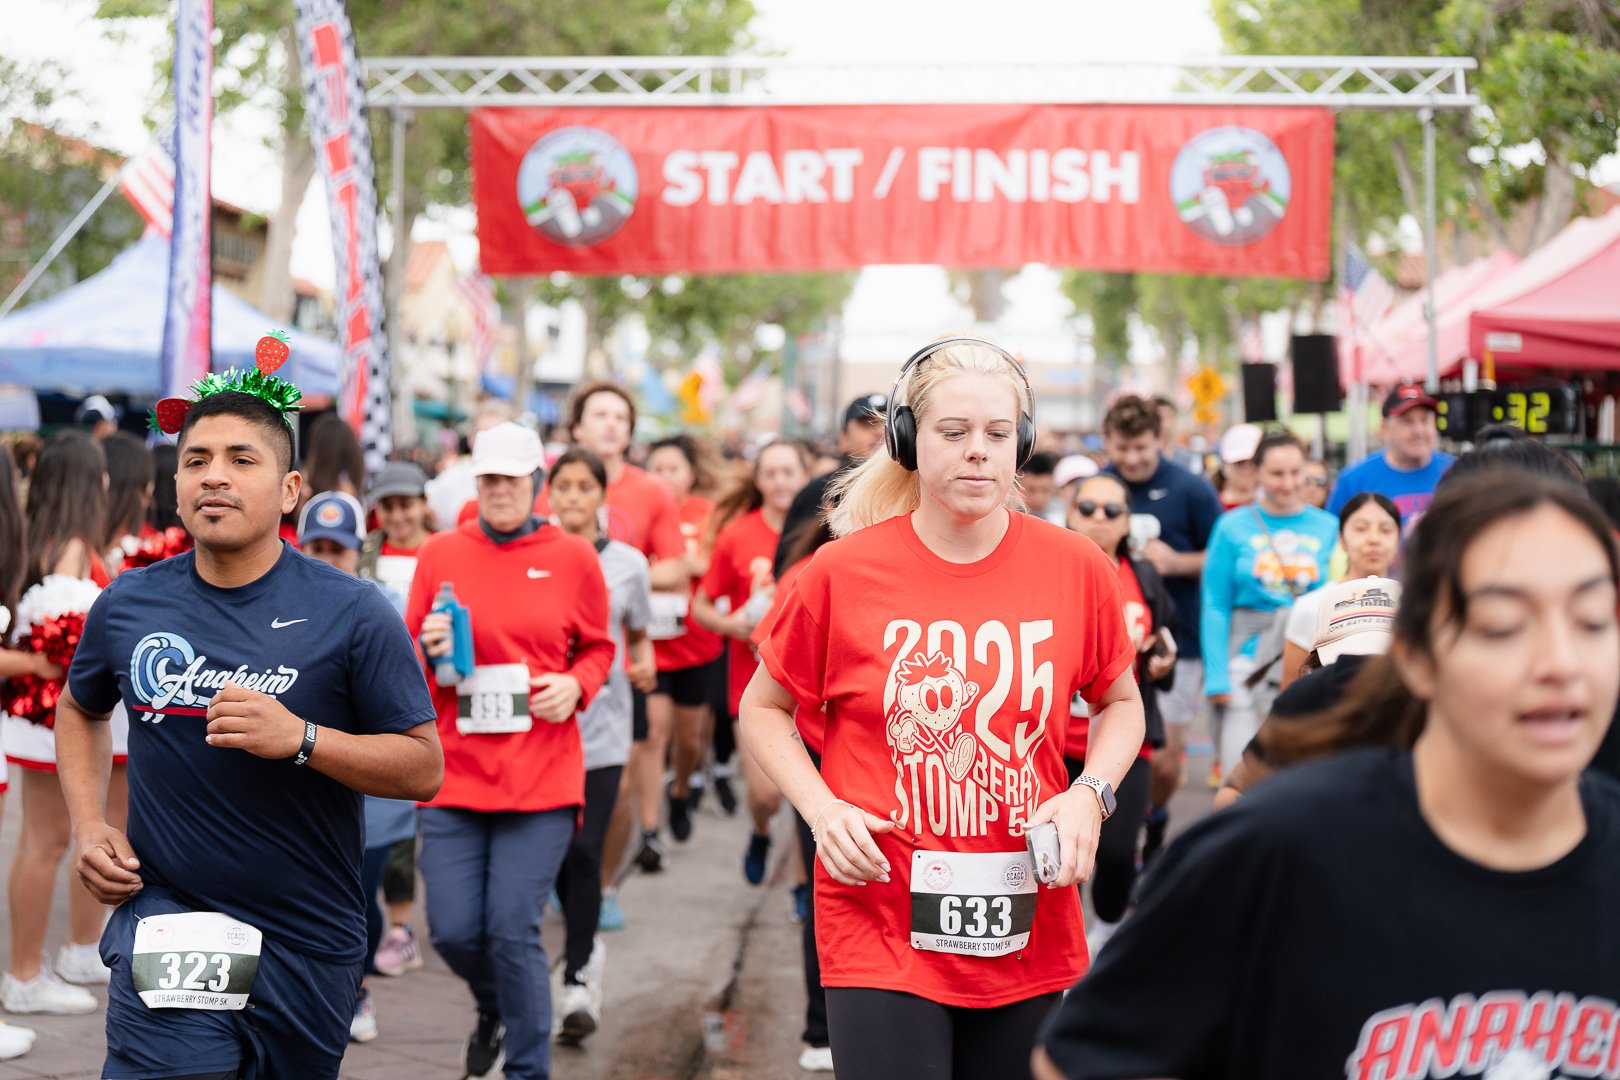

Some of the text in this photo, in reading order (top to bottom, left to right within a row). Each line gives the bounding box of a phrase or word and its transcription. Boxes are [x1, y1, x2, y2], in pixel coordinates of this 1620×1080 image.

[661, 146, 1141, 207] START / FINISH
[150, 655, 299, 710] Anaheim
[883, 618, 1054, 763] 2025
[889, 750, 999, 838] STOMP
[939, 895, 1013, 937] 633
[935, 938, 1012, 952] STRAWBERRY STOMP 5K
[158, 952, 232, 993] 323
[153, 994, 229, 1006] STRAWBERRY STOMP 5K
